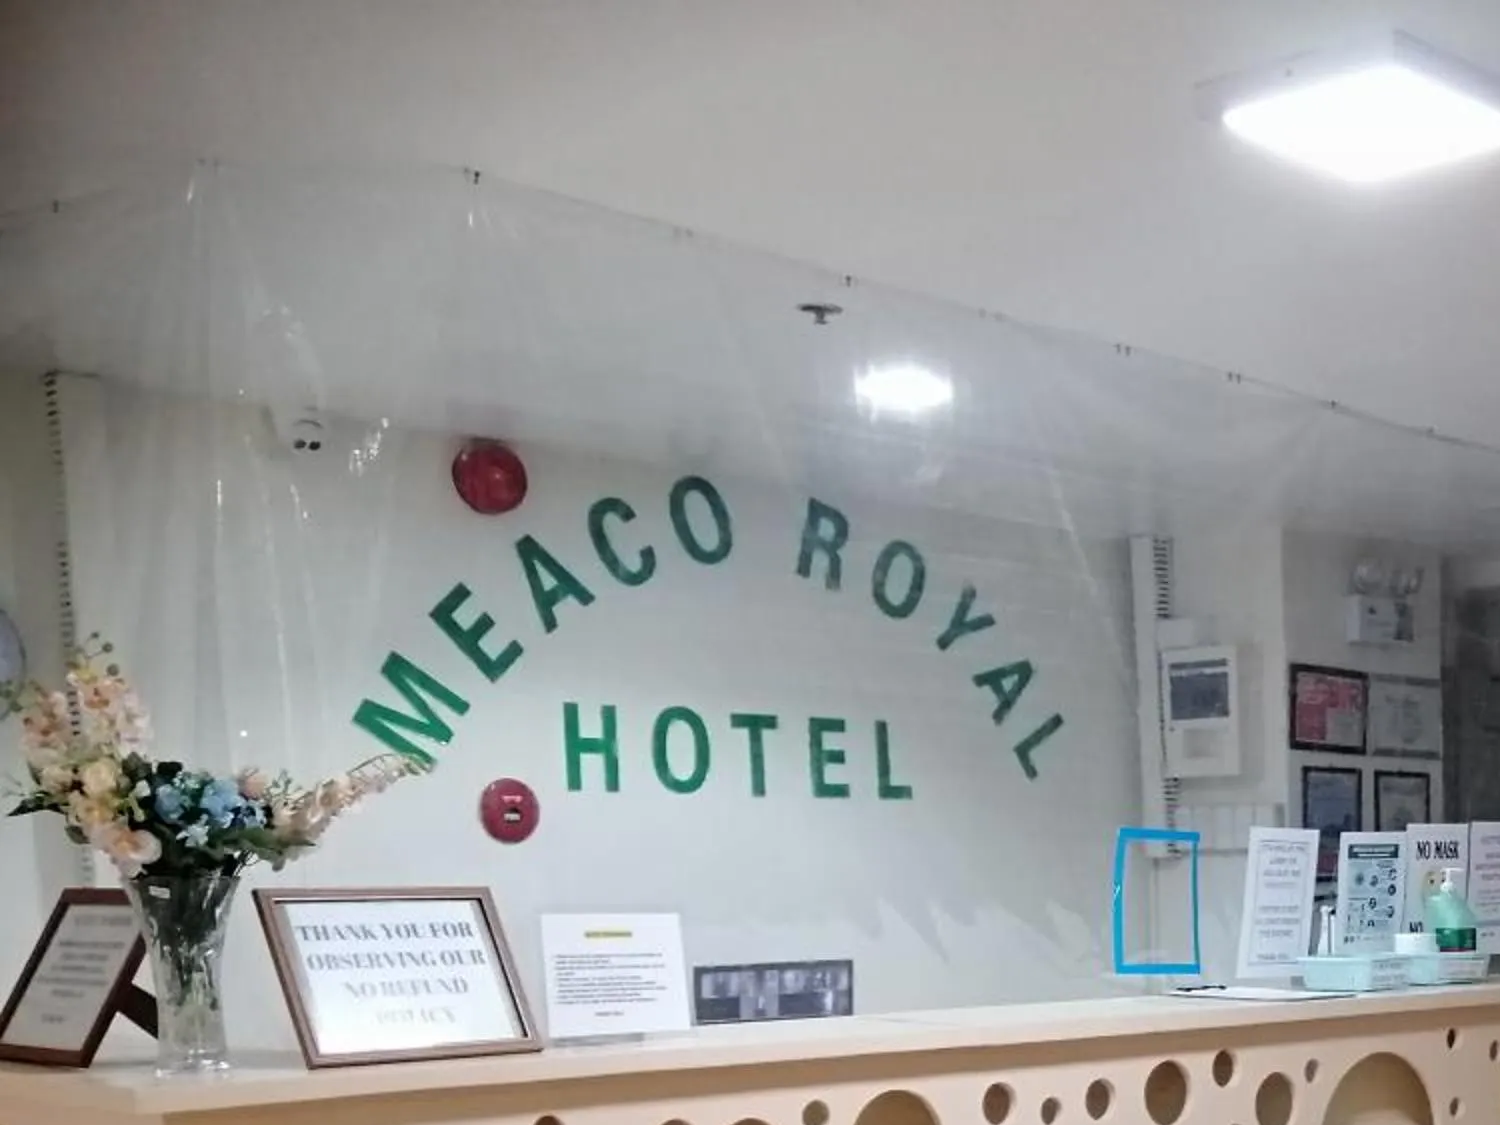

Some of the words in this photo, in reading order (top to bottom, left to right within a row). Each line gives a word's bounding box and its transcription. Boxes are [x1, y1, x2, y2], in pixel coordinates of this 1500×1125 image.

[352, 475, 733, 768] MEACO
[796, 497, 1064, 781] ROYAL
[562, 701, 913, 800] HOTEL
[1416, 841, 1432, 860] NO
[1433, 840, 1460, 860] MASK
[296, 923, 379, 942] THANK
[379, 922, 425, 941] YOU
[429, 921, 474, 940] FOR
[306, 949, 437, 971] OBSERVING
[440, 948, 487, 966] OUR
